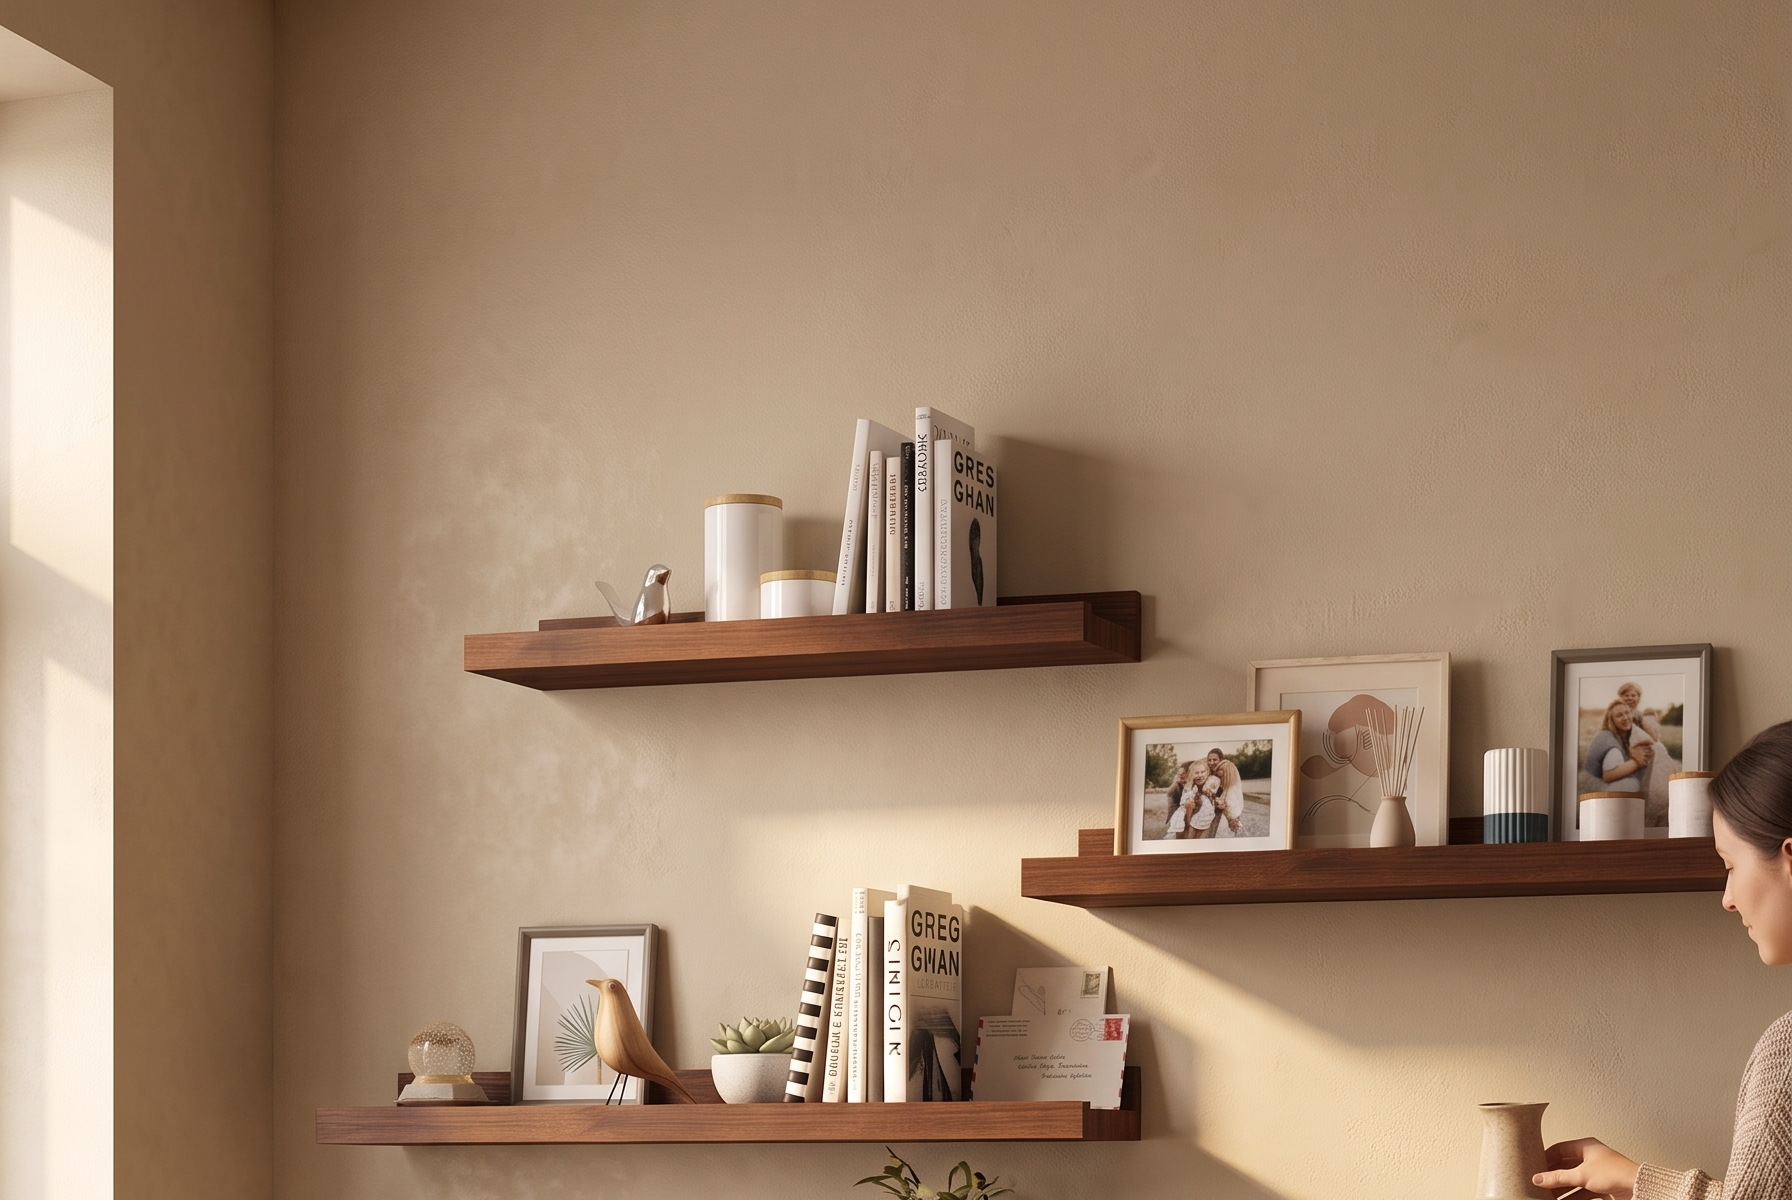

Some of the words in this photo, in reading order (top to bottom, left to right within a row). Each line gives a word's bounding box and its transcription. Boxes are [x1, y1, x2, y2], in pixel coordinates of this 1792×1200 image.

[954, 450, 995, 488] GRES
[954, 479, 995, 517] GHAN
[911, 909, 960, 943] GREG
